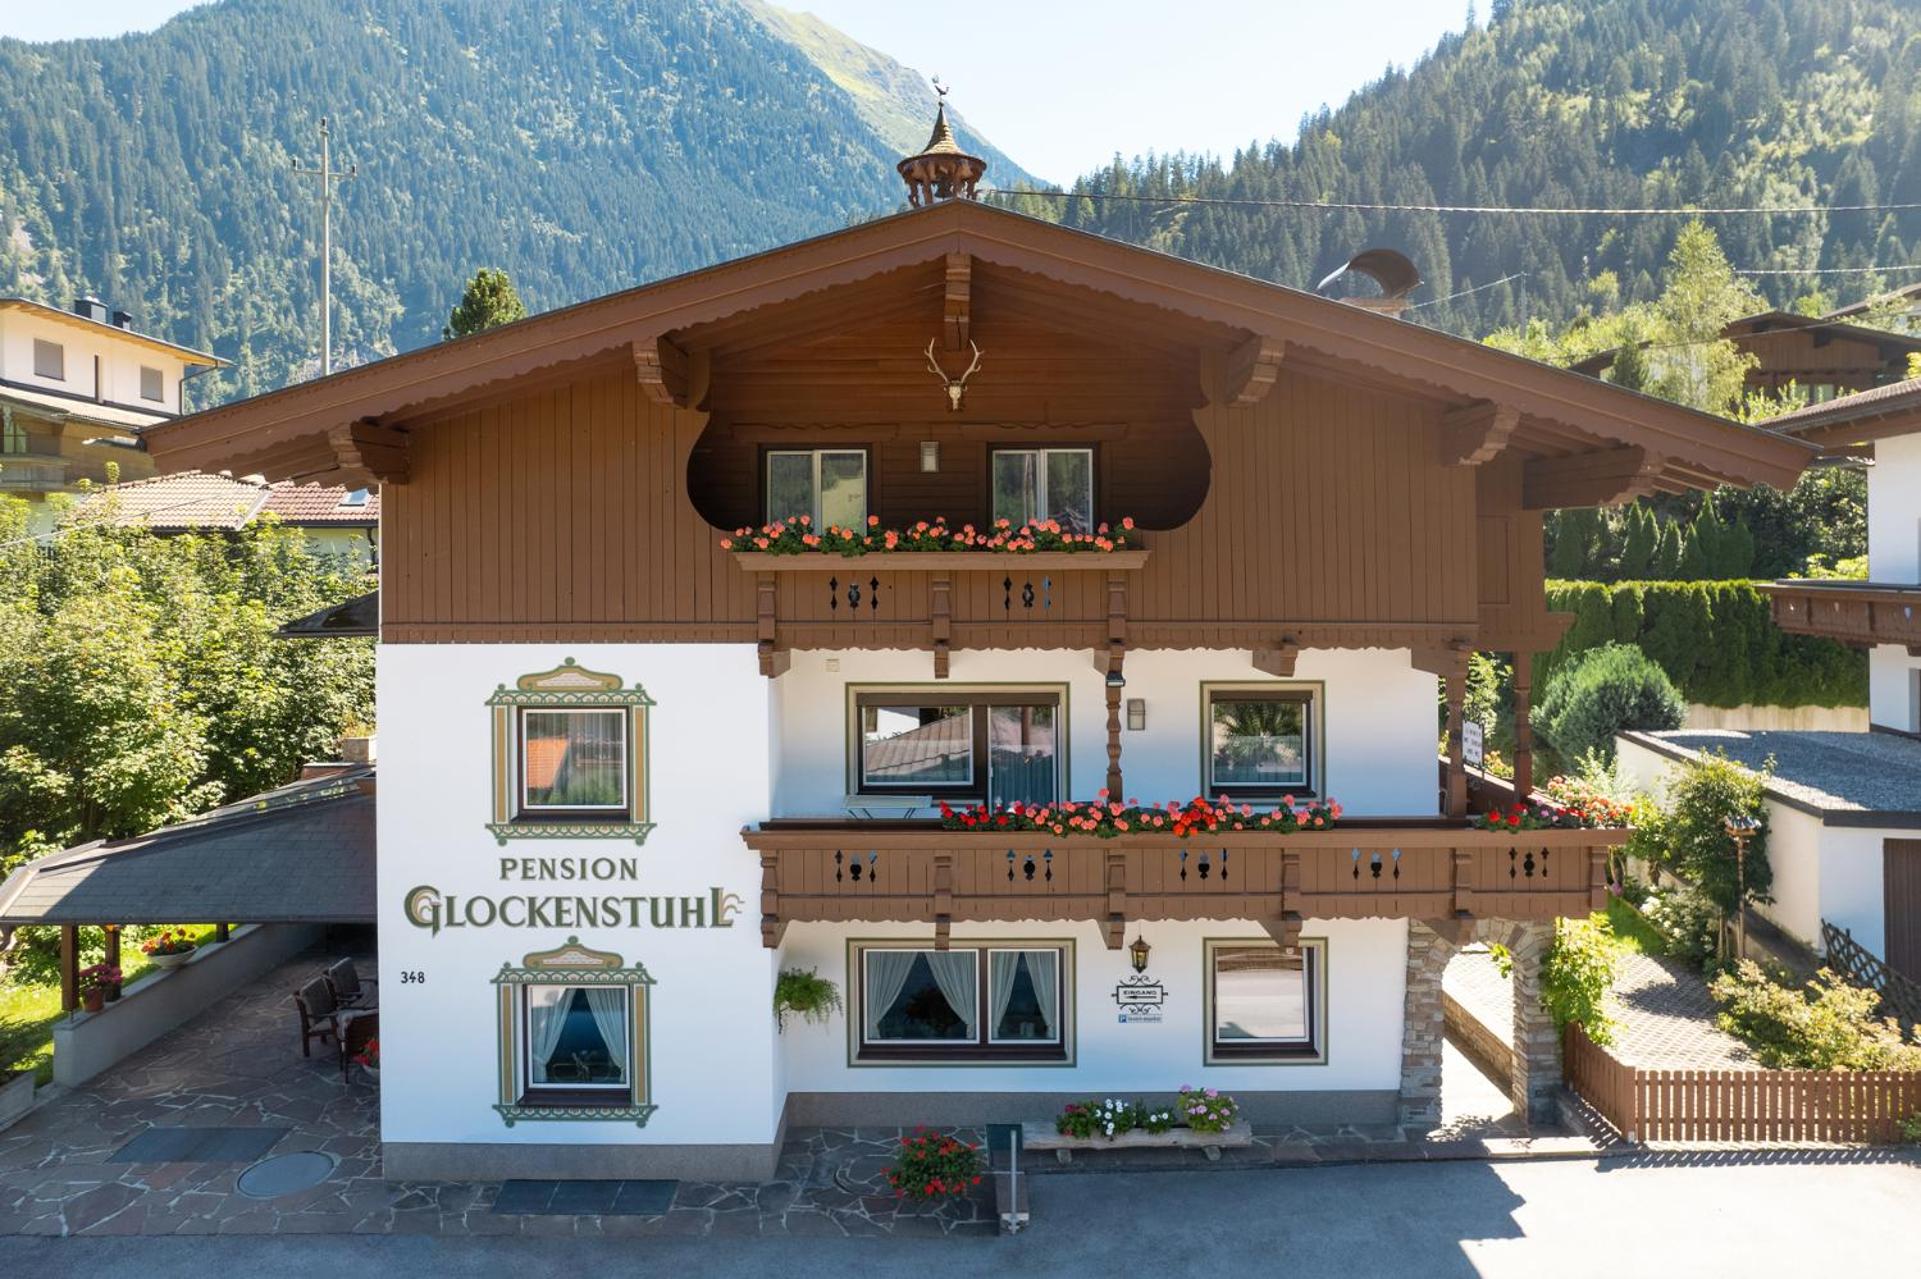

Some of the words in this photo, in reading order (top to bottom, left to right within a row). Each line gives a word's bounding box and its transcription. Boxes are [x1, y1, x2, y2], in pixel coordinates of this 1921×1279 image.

[500, 857, 638, 881] PENSION
[404, 885, 738, 938] GLOCKENSTUHL
[400, 971, 425, 984] 348
